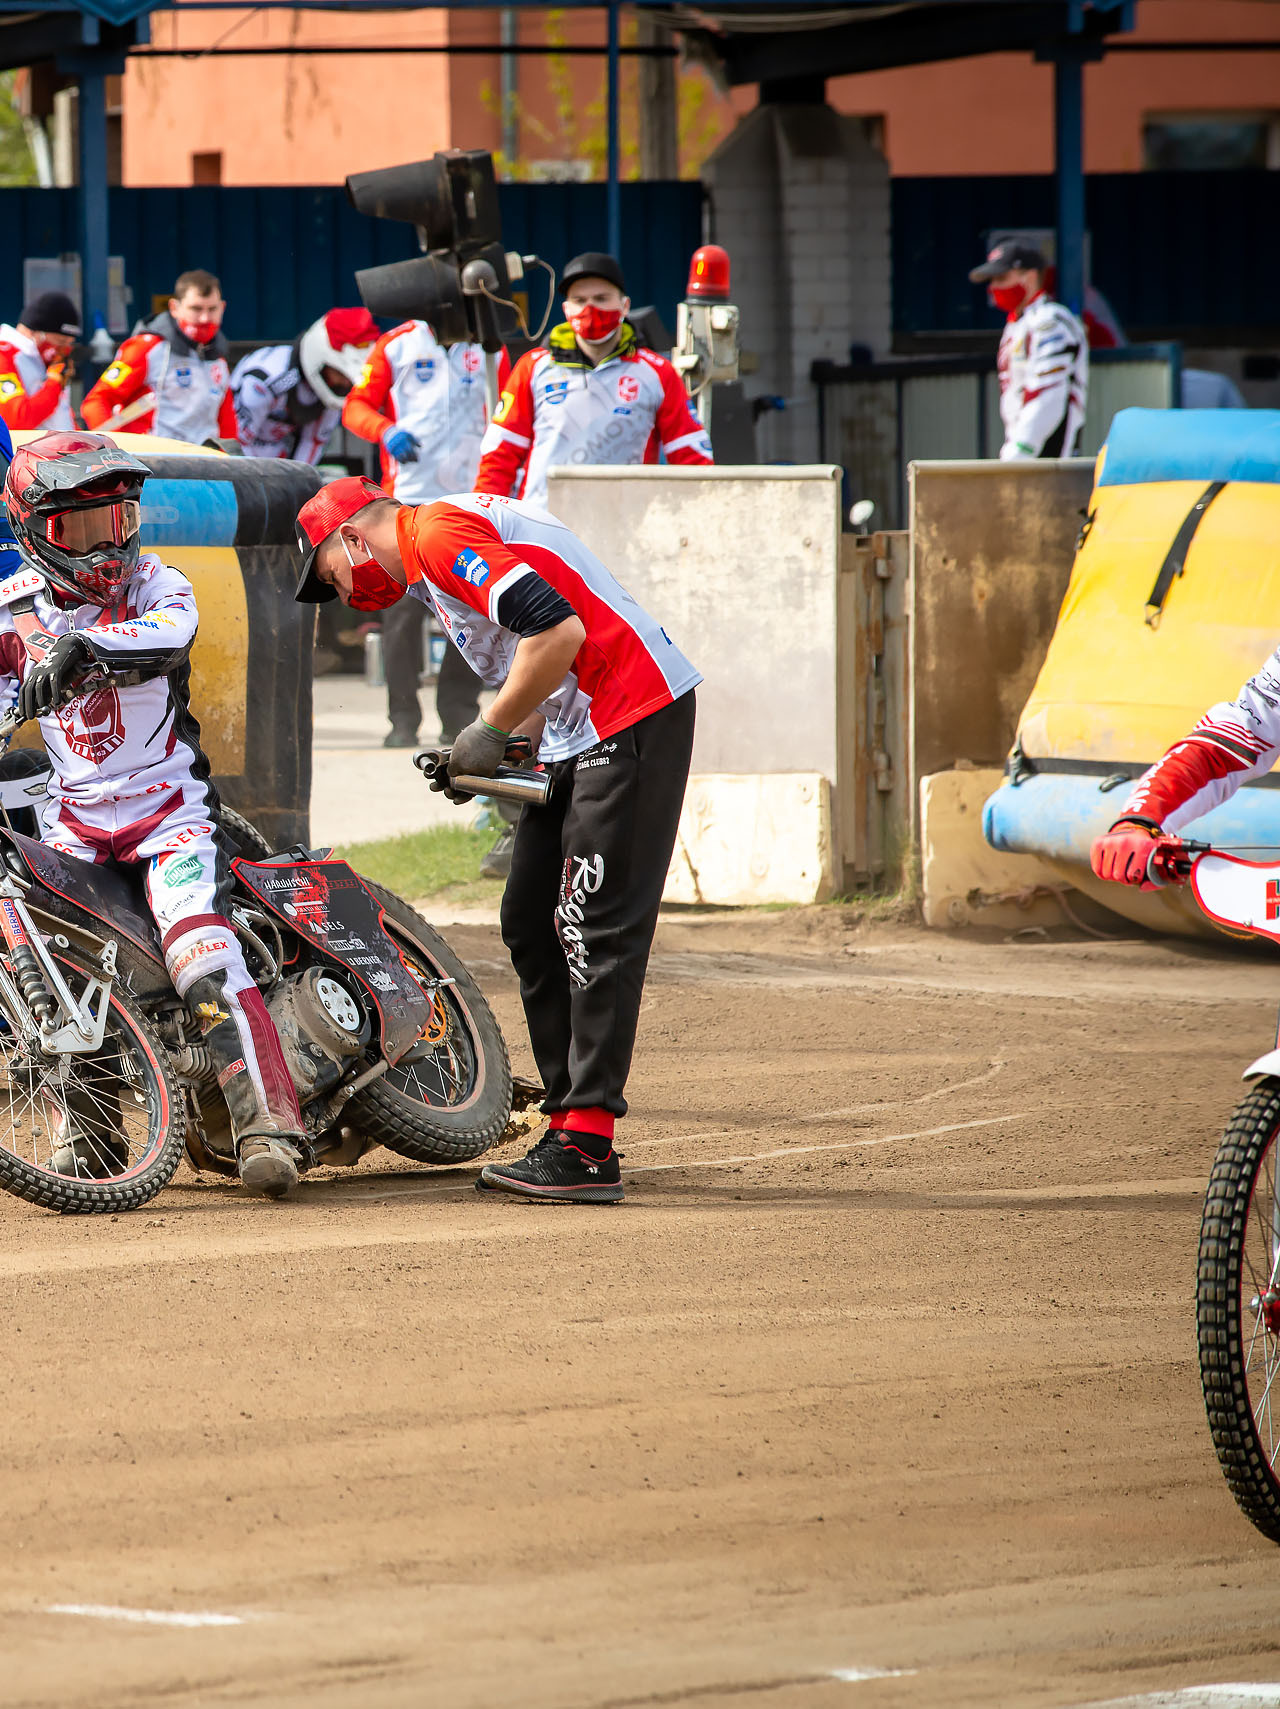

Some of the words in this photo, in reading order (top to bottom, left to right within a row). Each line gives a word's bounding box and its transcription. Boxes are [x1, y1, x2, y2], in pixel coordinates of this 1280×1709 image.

[2, 575, 40, 597] SELS
[3, 901, 22, 935] BERNER
[321, 920, 345, 932] SELS
[354, 955, 383, 966] BERNER
